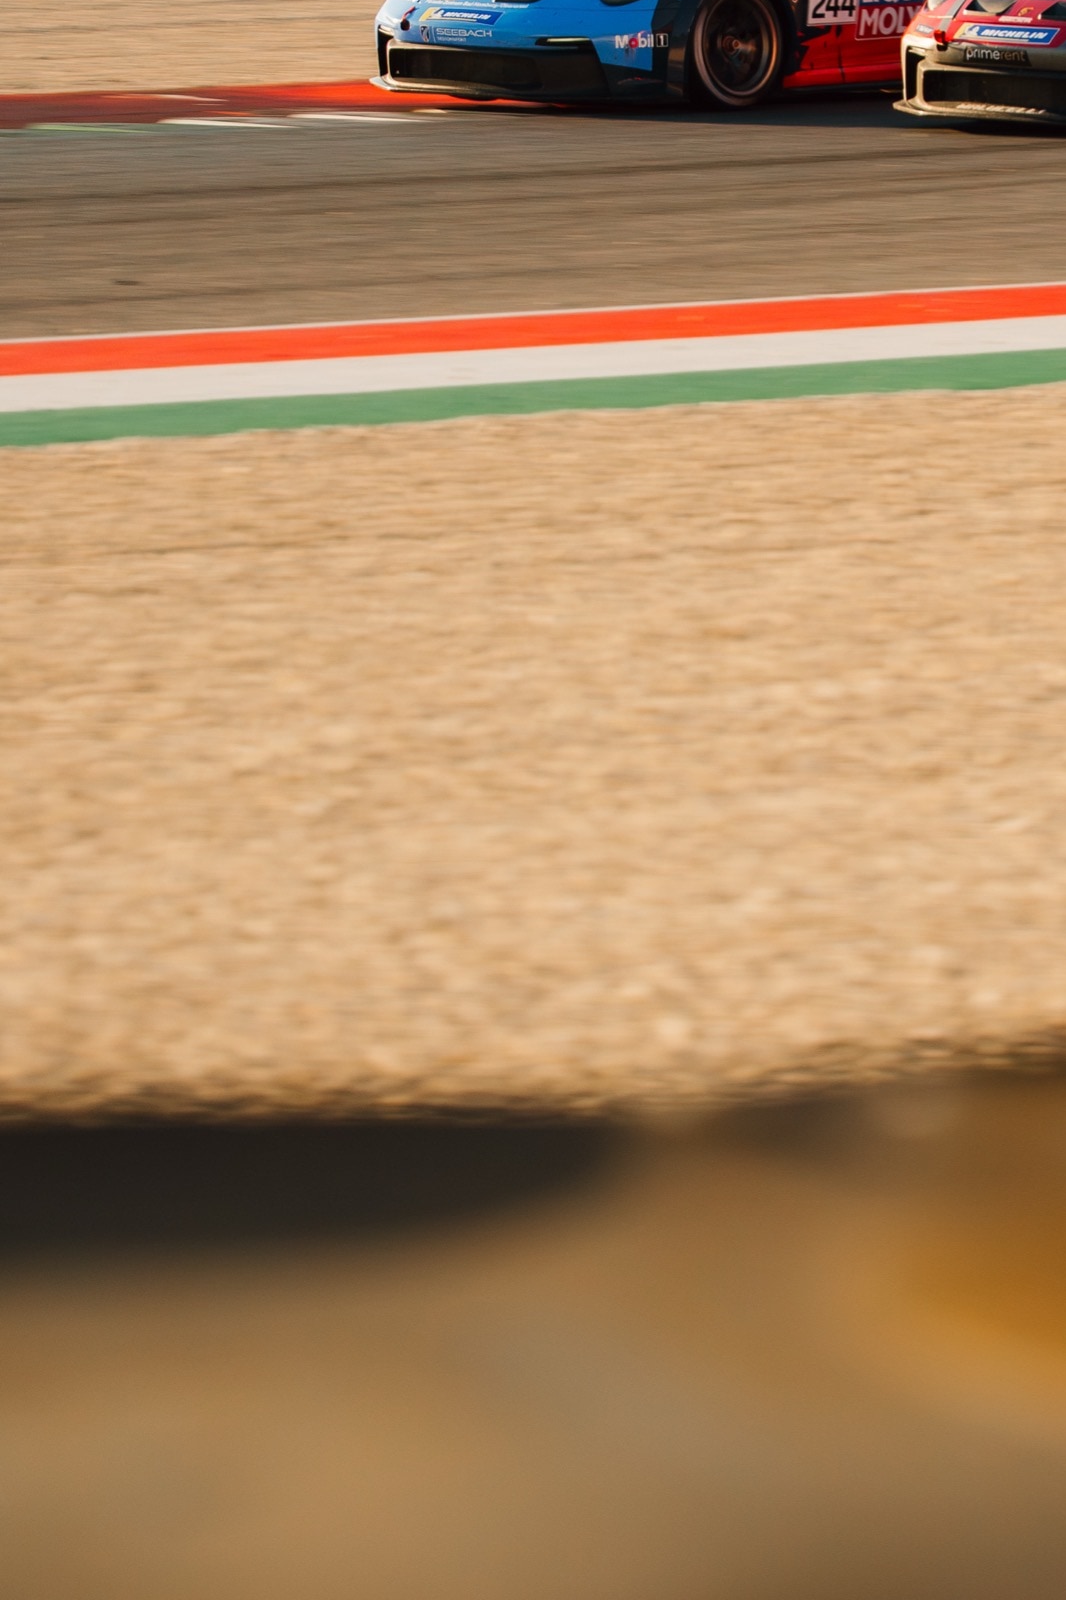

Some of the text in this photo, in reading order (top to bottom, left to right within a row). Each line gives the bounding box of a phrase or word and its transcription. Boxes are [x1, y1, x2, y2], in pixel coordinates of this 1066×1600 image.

[435, 27, 493, 37] SEEBACH
[980, 28, 1048, 39] MICHELIN
[615, 32, 654, 49] Mobil
[966, 48, 1026, 61] primerent
